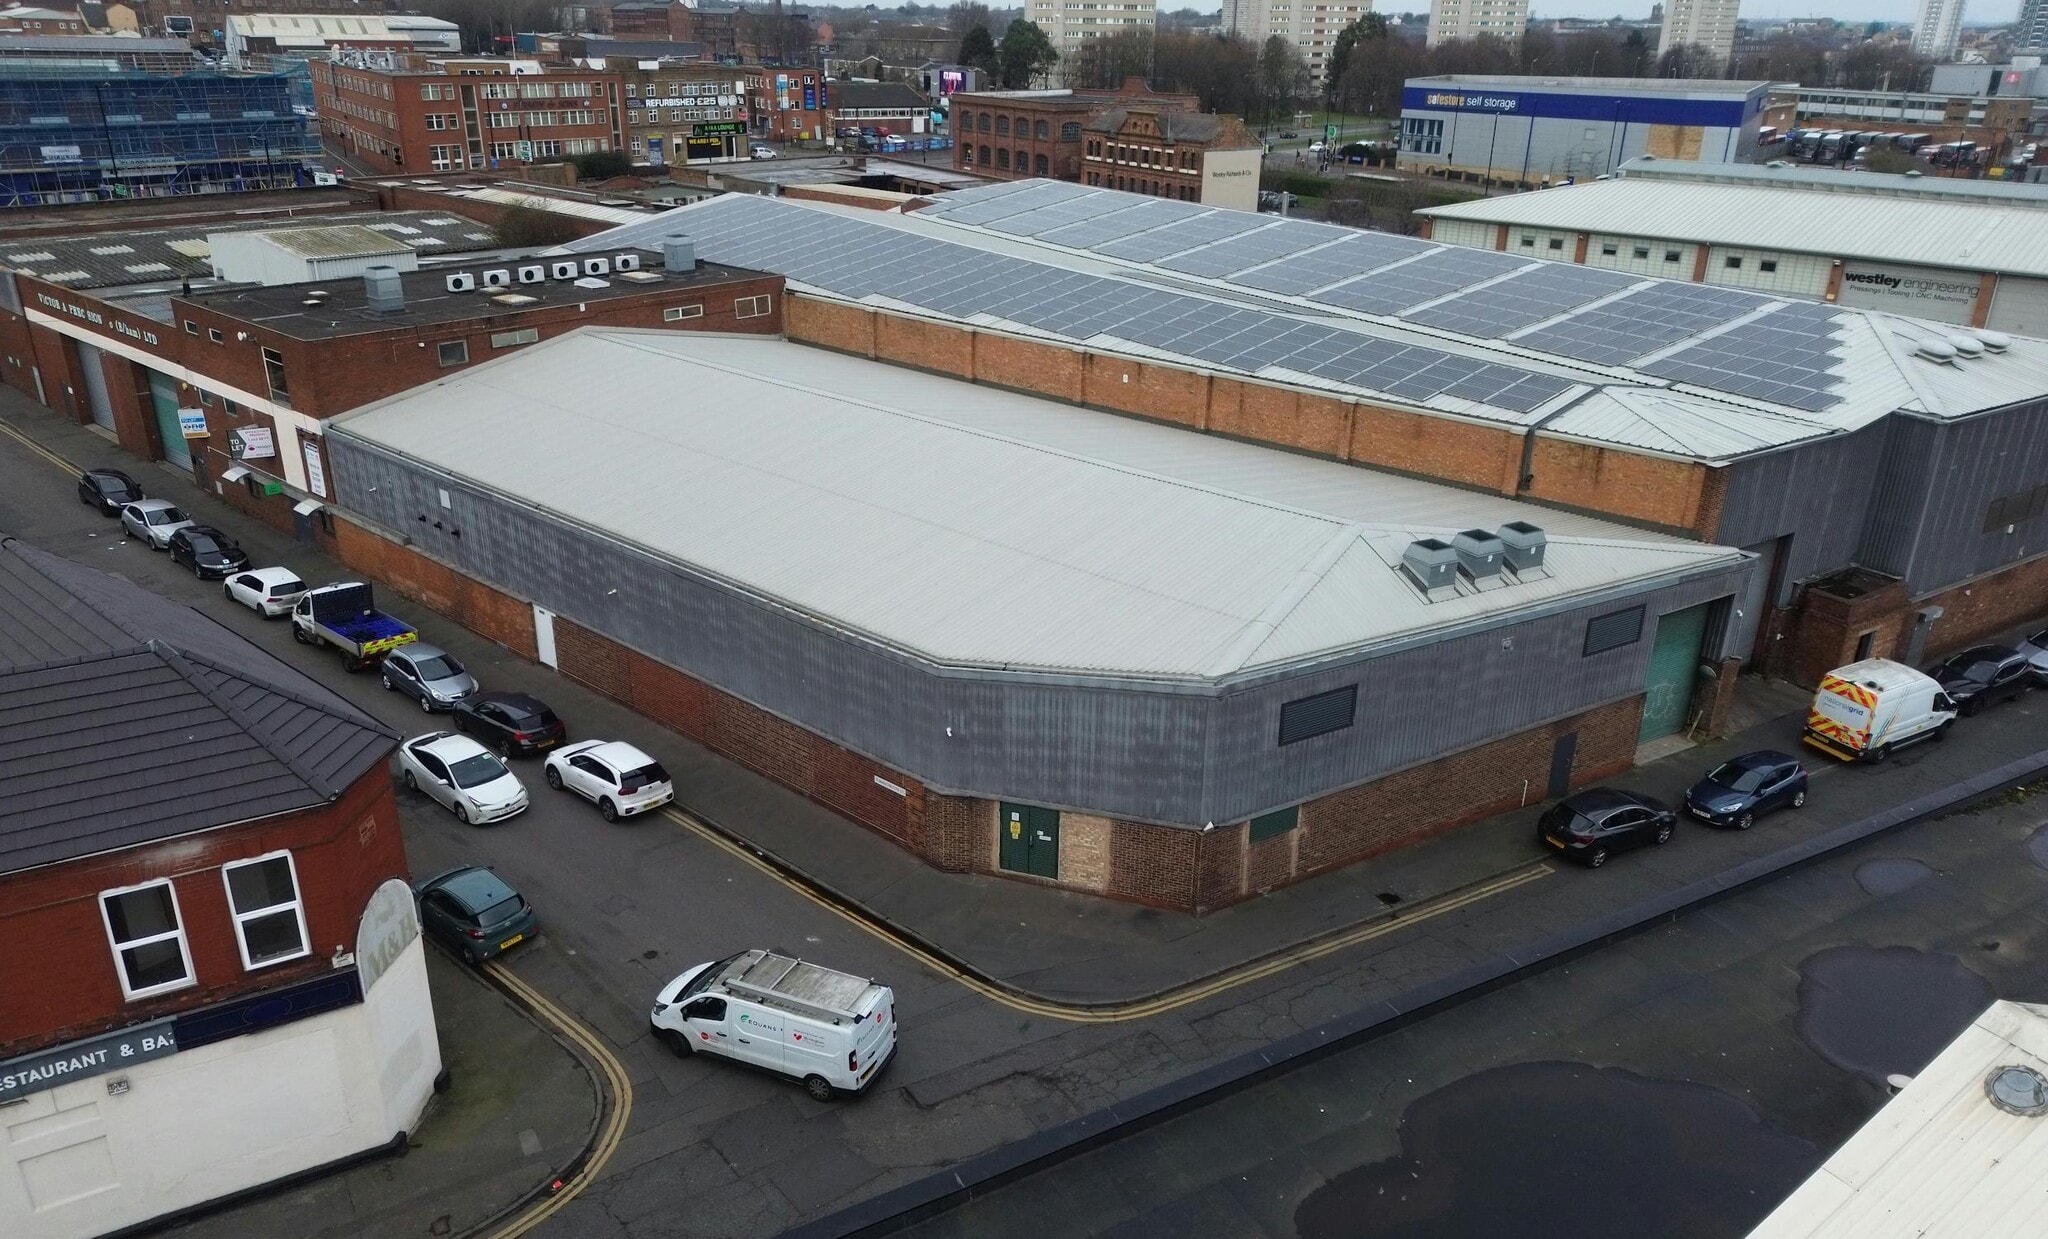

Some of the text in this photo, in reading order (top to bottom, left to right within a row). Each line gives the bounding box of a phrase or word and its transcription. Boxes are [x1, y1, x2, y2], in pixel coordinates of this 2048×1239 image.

[645, 98, 695, 107] REFURBISHED
[696, 97, 716, 106] £25
[1426, 93, 1516, 110] safestore self storage
[1845, 272, 1980, 299] westley engineering
[1849, 284, 1969, 305] Pressings Tooling CNC Machining
[143, 330, 159, 346] LTD
[231, 444, 244, 452] LET
[748, 1019, 777, 1032] EQUANS
[119, 1043, 135, 1058] &
